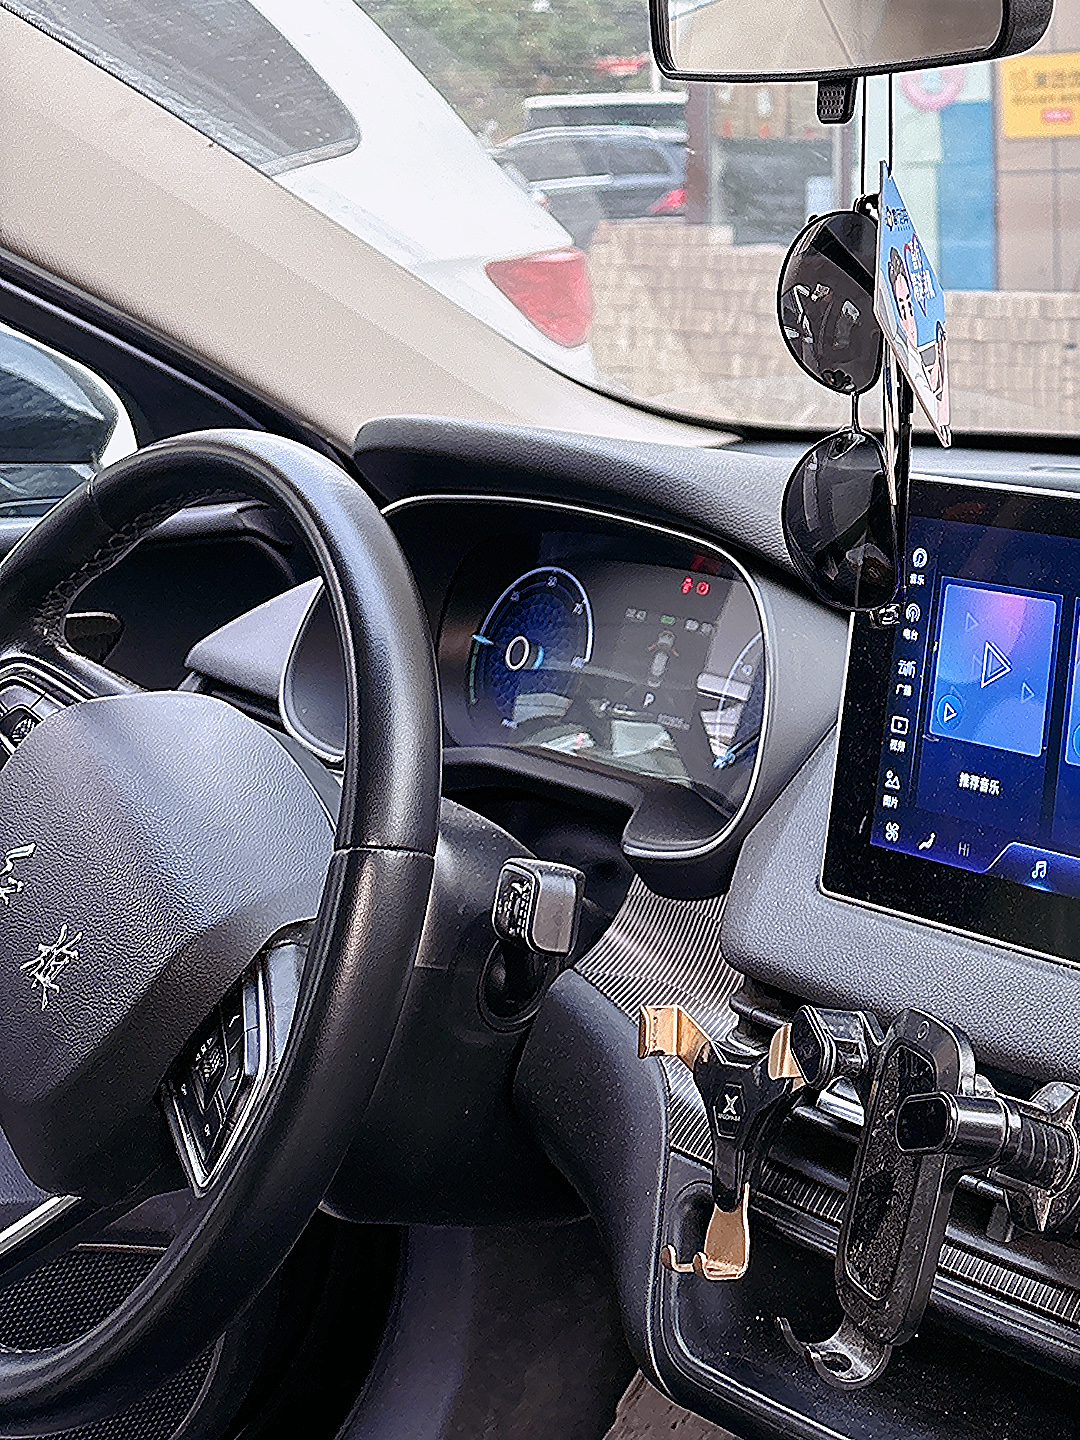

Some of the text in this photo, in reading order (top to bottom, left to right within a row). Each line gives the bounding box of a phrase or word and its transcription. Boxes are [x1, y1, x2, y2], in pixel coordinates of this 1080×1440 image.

[505, 635, 530, 672] 0
[643, 692, 656, 709] P
[958, 771, 1000, 797] 推荐音乐
[957, 841, 970, 858] Hi
